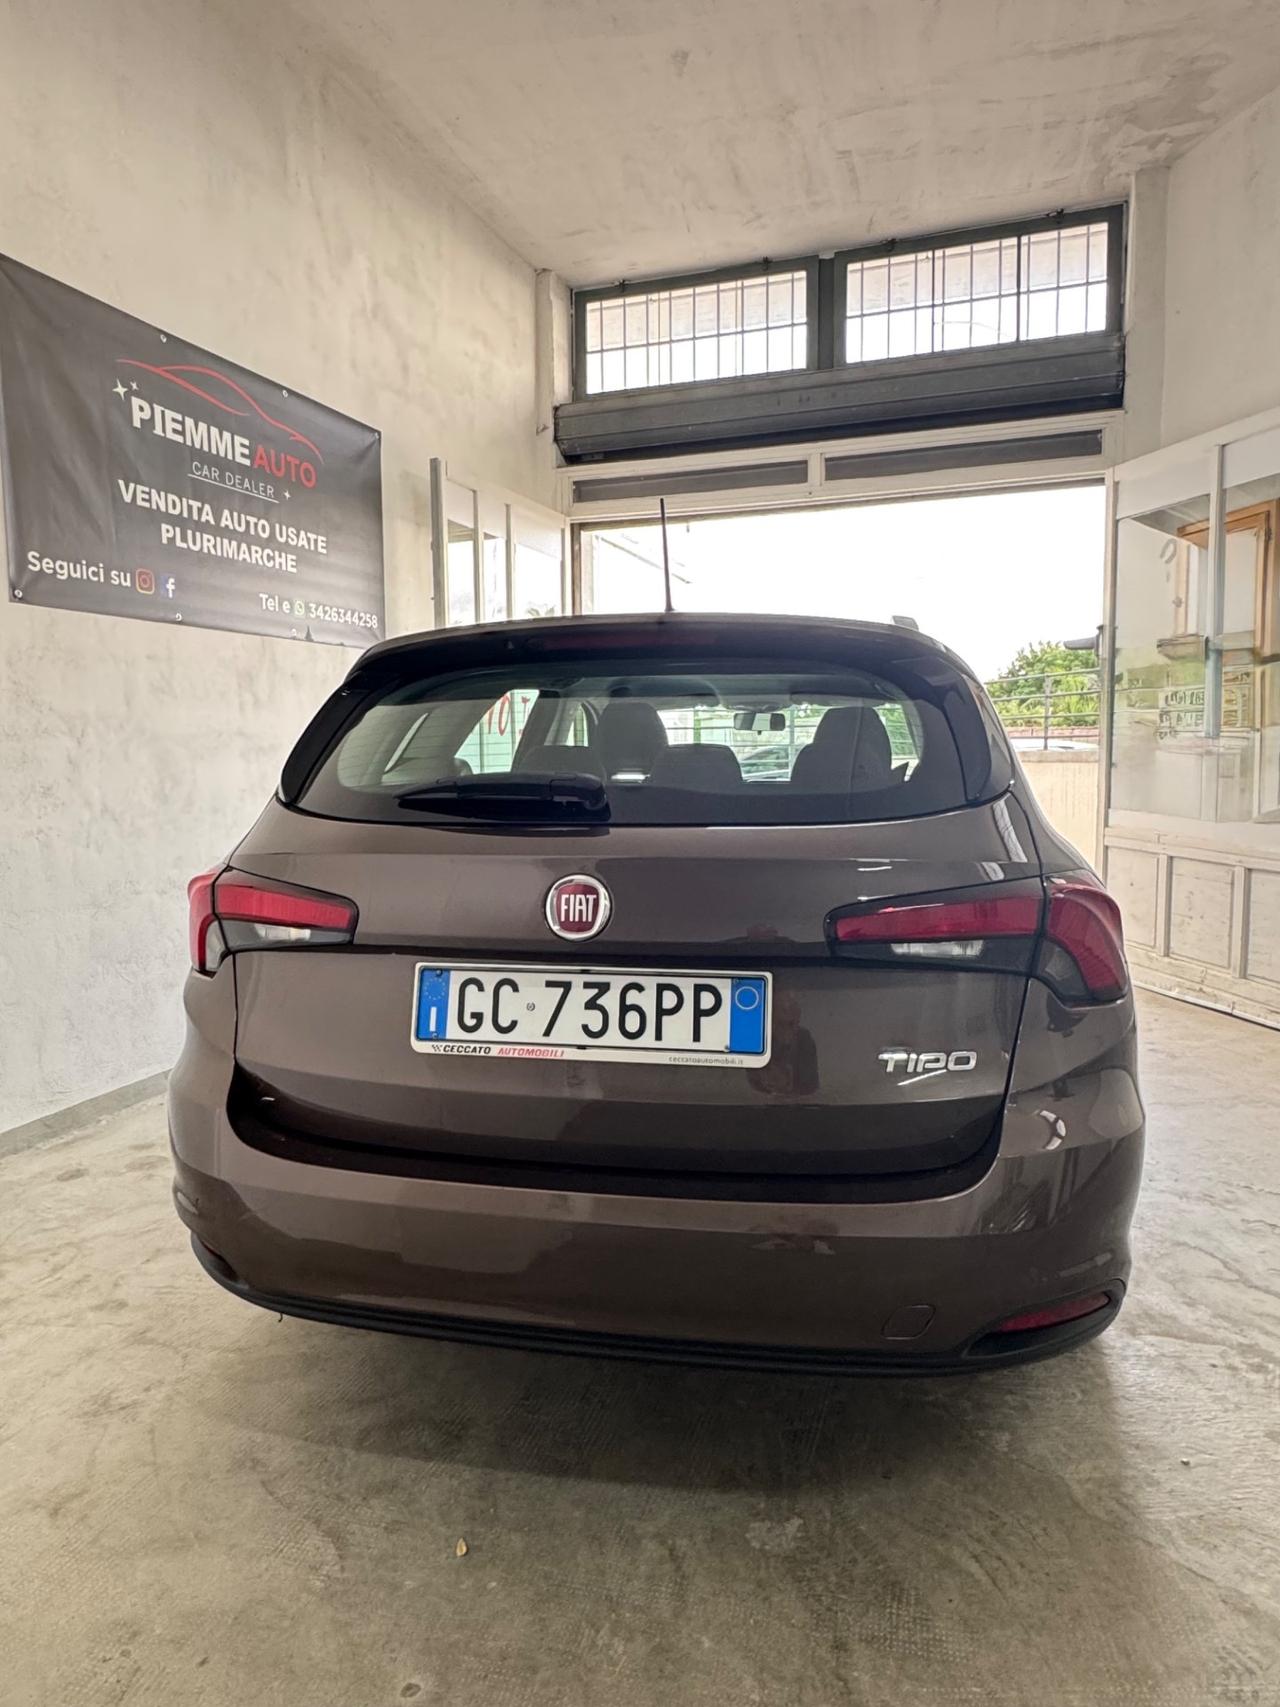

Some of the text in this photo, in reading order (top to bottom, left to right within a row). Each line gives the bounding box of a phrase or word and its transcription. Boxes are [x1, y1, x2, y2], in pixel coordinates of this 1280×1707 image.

[192, 461, 275, 498] CAR DEALER
[117, 479, 327, 554] VENDITA AUTO USATE
[161, 523, 298, 573] PLURIMARCHE
[27, 551, 104, 583] Seguici
[110, 570, 131, 587] su
[259, 593, 378, 629] Tel e 3426344258
[561, 894, 597, 922] FIAT
[443, 1044, 565, 1058] CECCATO AUTOMOBILI
[878, 1051, 977, 1073] TIPO
